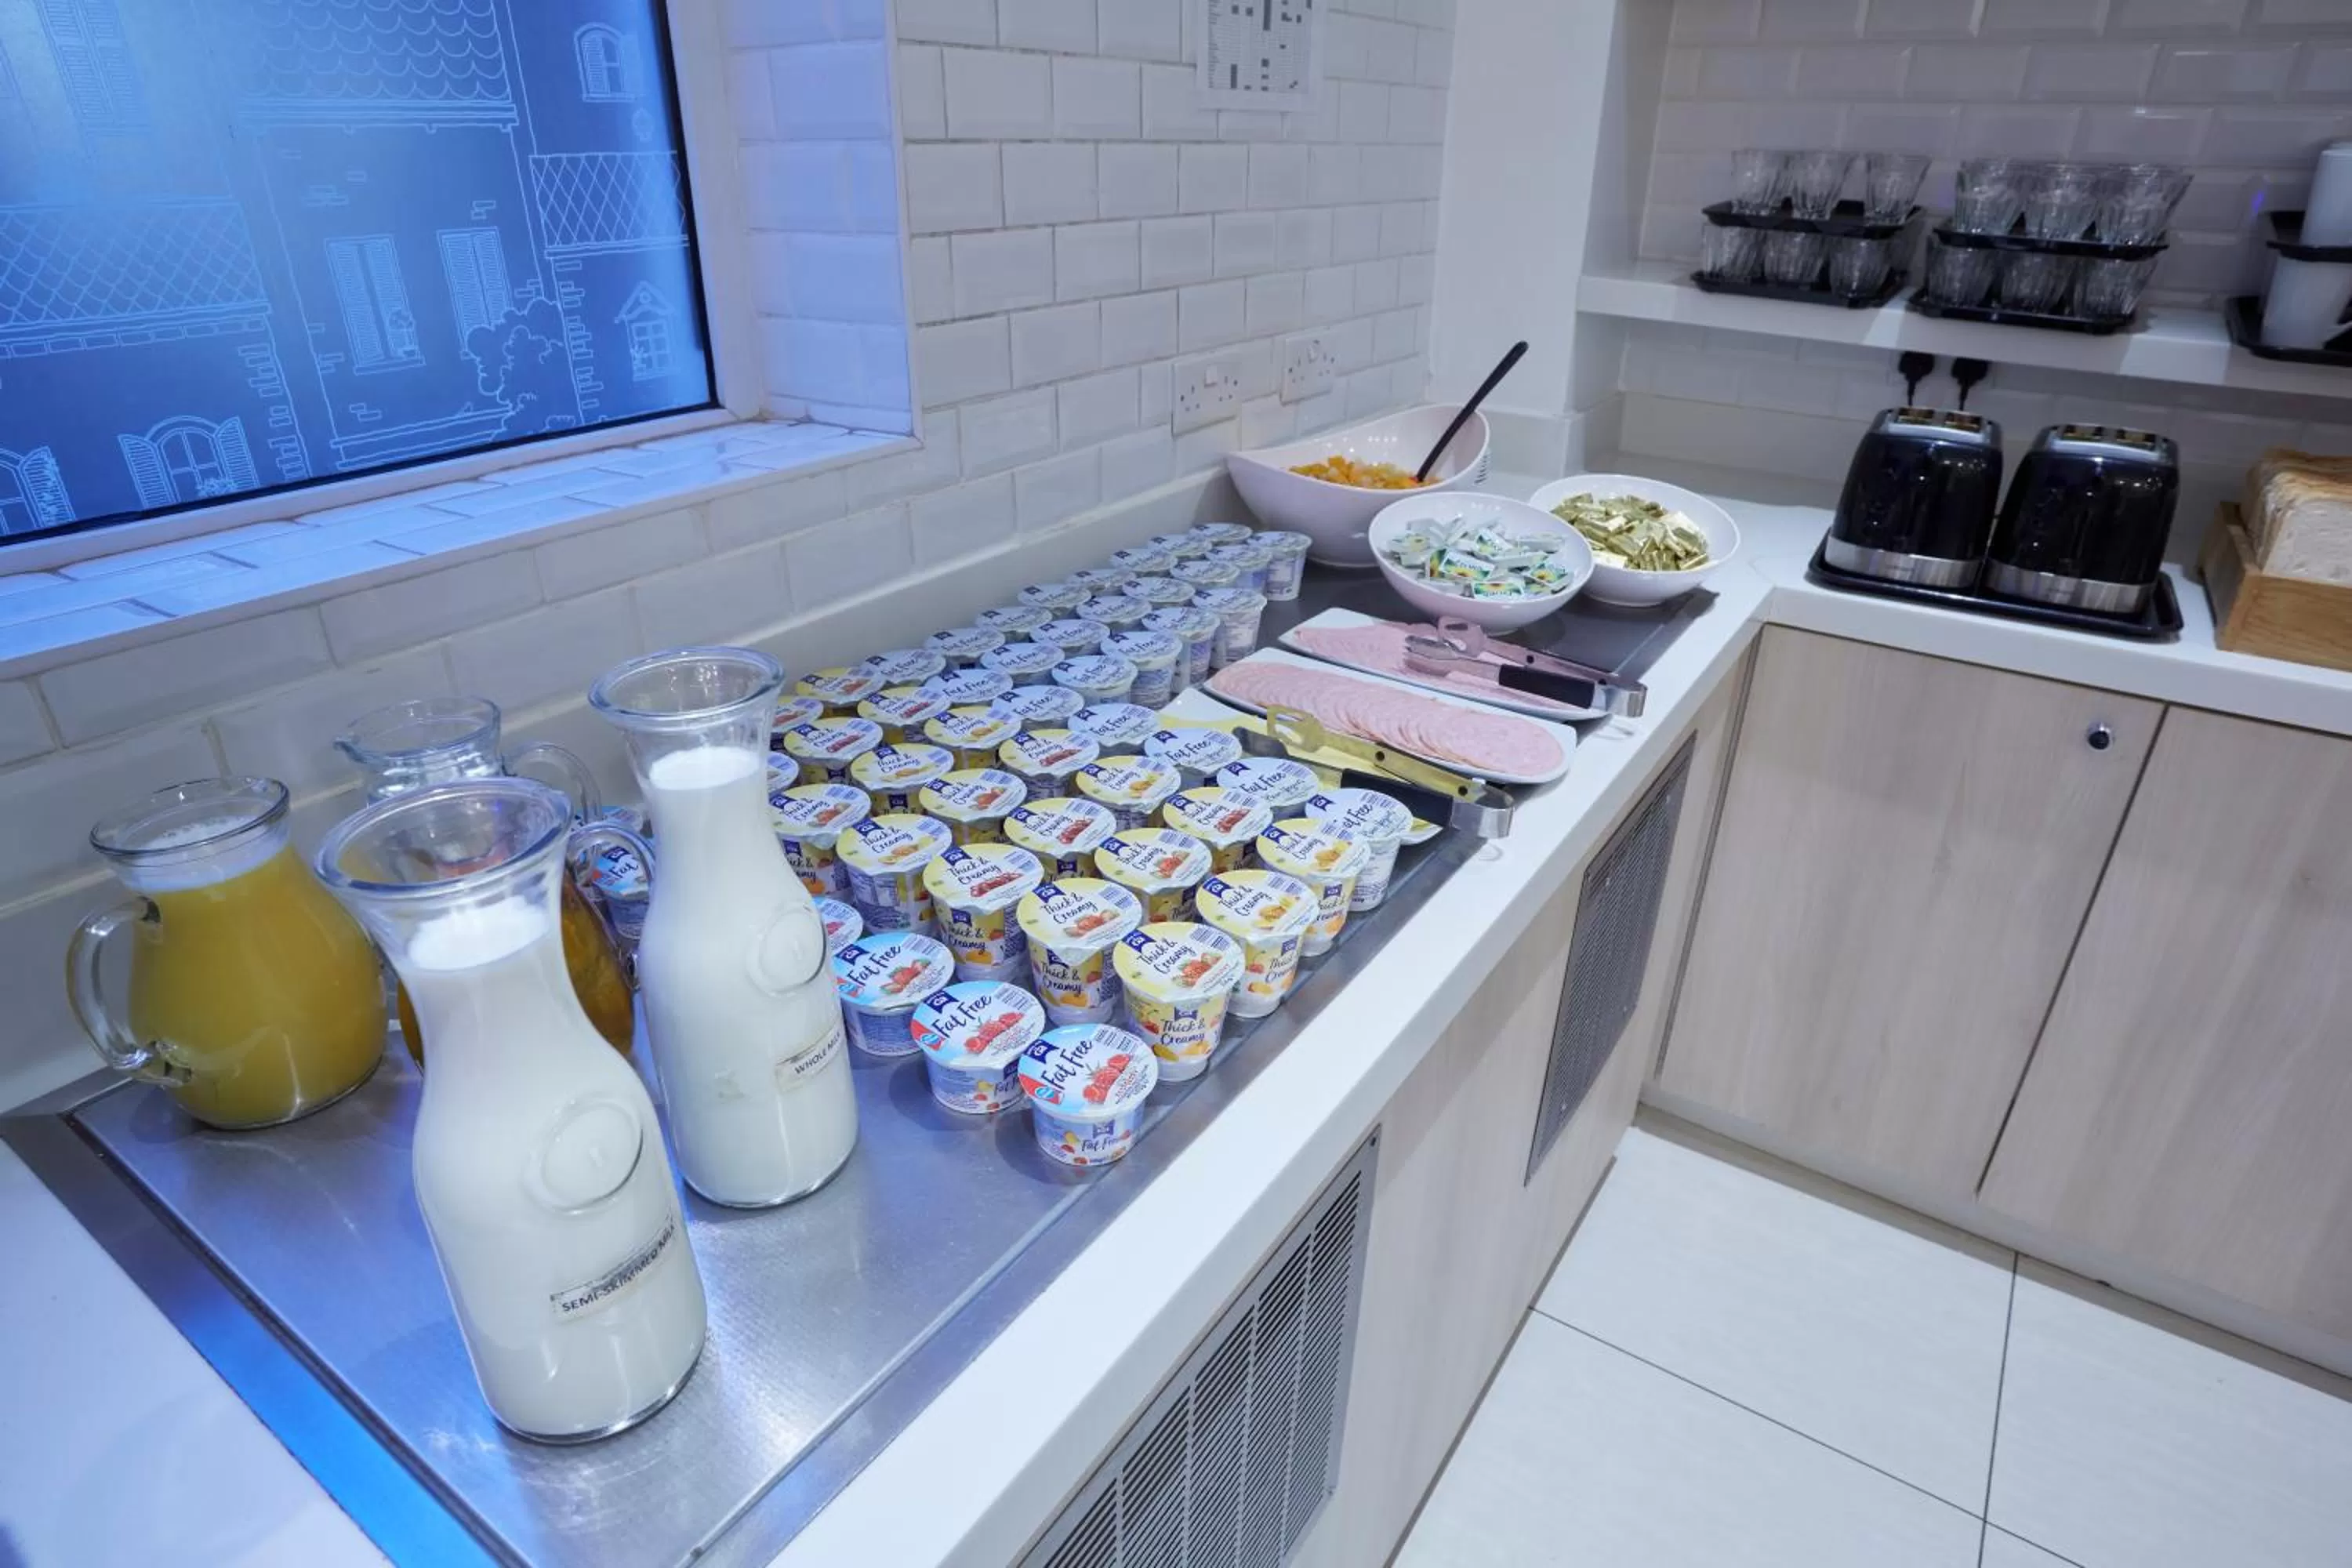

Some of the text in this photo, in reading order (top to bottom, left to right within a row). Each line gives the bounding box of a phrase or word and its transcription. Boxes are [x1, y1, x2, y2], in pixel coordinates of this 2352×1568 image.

[1105, 715, 1130, 728] Free
[1165, 749, 1191, 762] Fat
[1184, 740, 1211, 753] Free
[1240, 782, 1268, 794] Fat
[1258, 771, 1287, 788] Free
[1347, 804, 1374, 823] Free
[871, 831, 914, 854] Creamy
[1292, 838, 1326, 860] Creamy
[947, 858, 978, 877] Thick
[1131, 847, 1167, 871] Creamy
[957, 865, 1002, 885] Creamy
[1040, 892, 1075, 915] Thick
[1218, 887, 1244, 909] Thick
[1234, 891, 1273, 916] Creamy
[1052, 900, 1098, 924] Creamy
[1137, 937, 1169, 967] Thick
[1153, 945, 1197, 975] Creamy
[847, 964, 881, 987] Fat
[869, 945, 901, 969] Free
[1041, 960, 1070, 981] Thick
[1043, 975, 1084, 998] Creamy
[931, 1014, 967, 1038] Fat
[956, 994, 992, 1020] Free
[1161, 1018, 1200, 1033] Thick
[1161, 1033, 1207, 1046] Creamy
[1040, 1039, 1093, 1091] Fat Free
[1081, 1138, 1101, 1152] Fat
[561, 1247, 659, 1312] SEMI-SKIMMED
